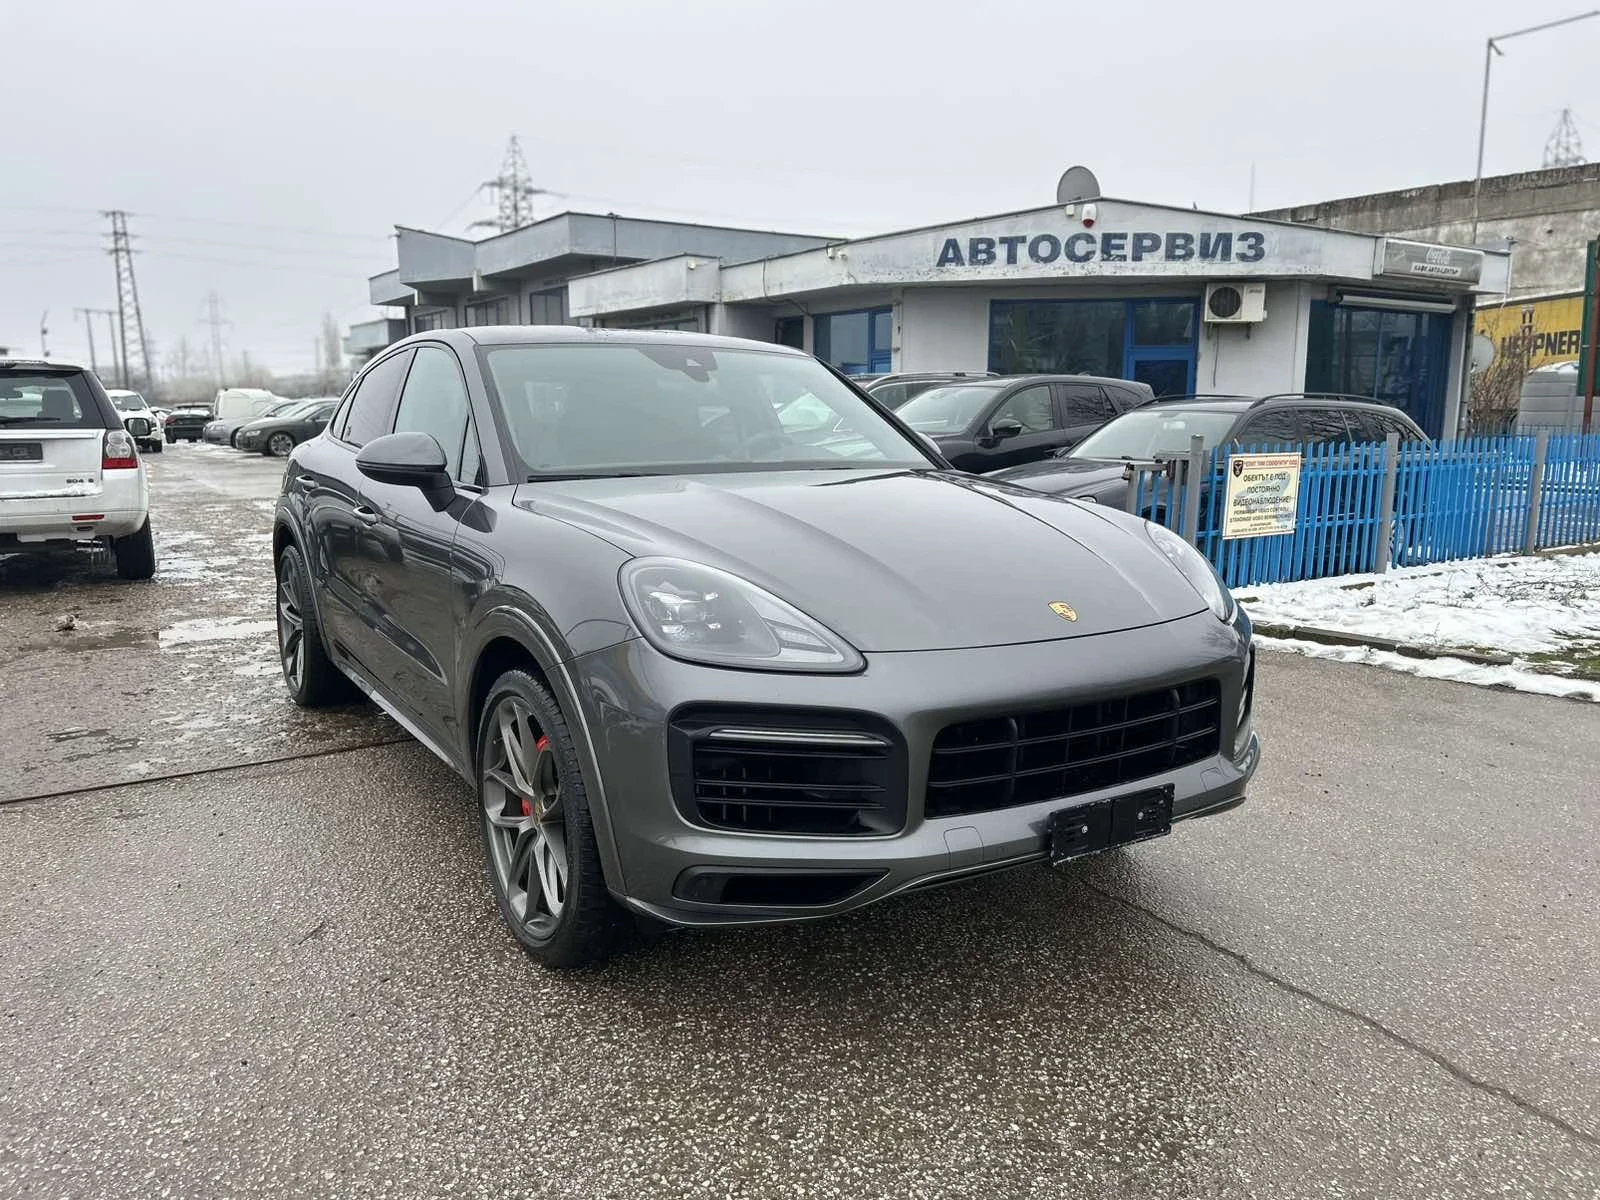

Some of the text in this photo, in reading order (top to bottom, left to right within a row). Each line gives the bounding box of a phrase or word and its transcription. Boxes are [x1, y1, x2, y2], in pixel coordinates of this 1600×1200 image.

[935, 231, 1266, 268] АВТОСЕРВИЗ
[1243, 474, 1269, 482] ОБЕКТЪТ
[1247, 485, 1281, 494] ПОСТОЯННО
